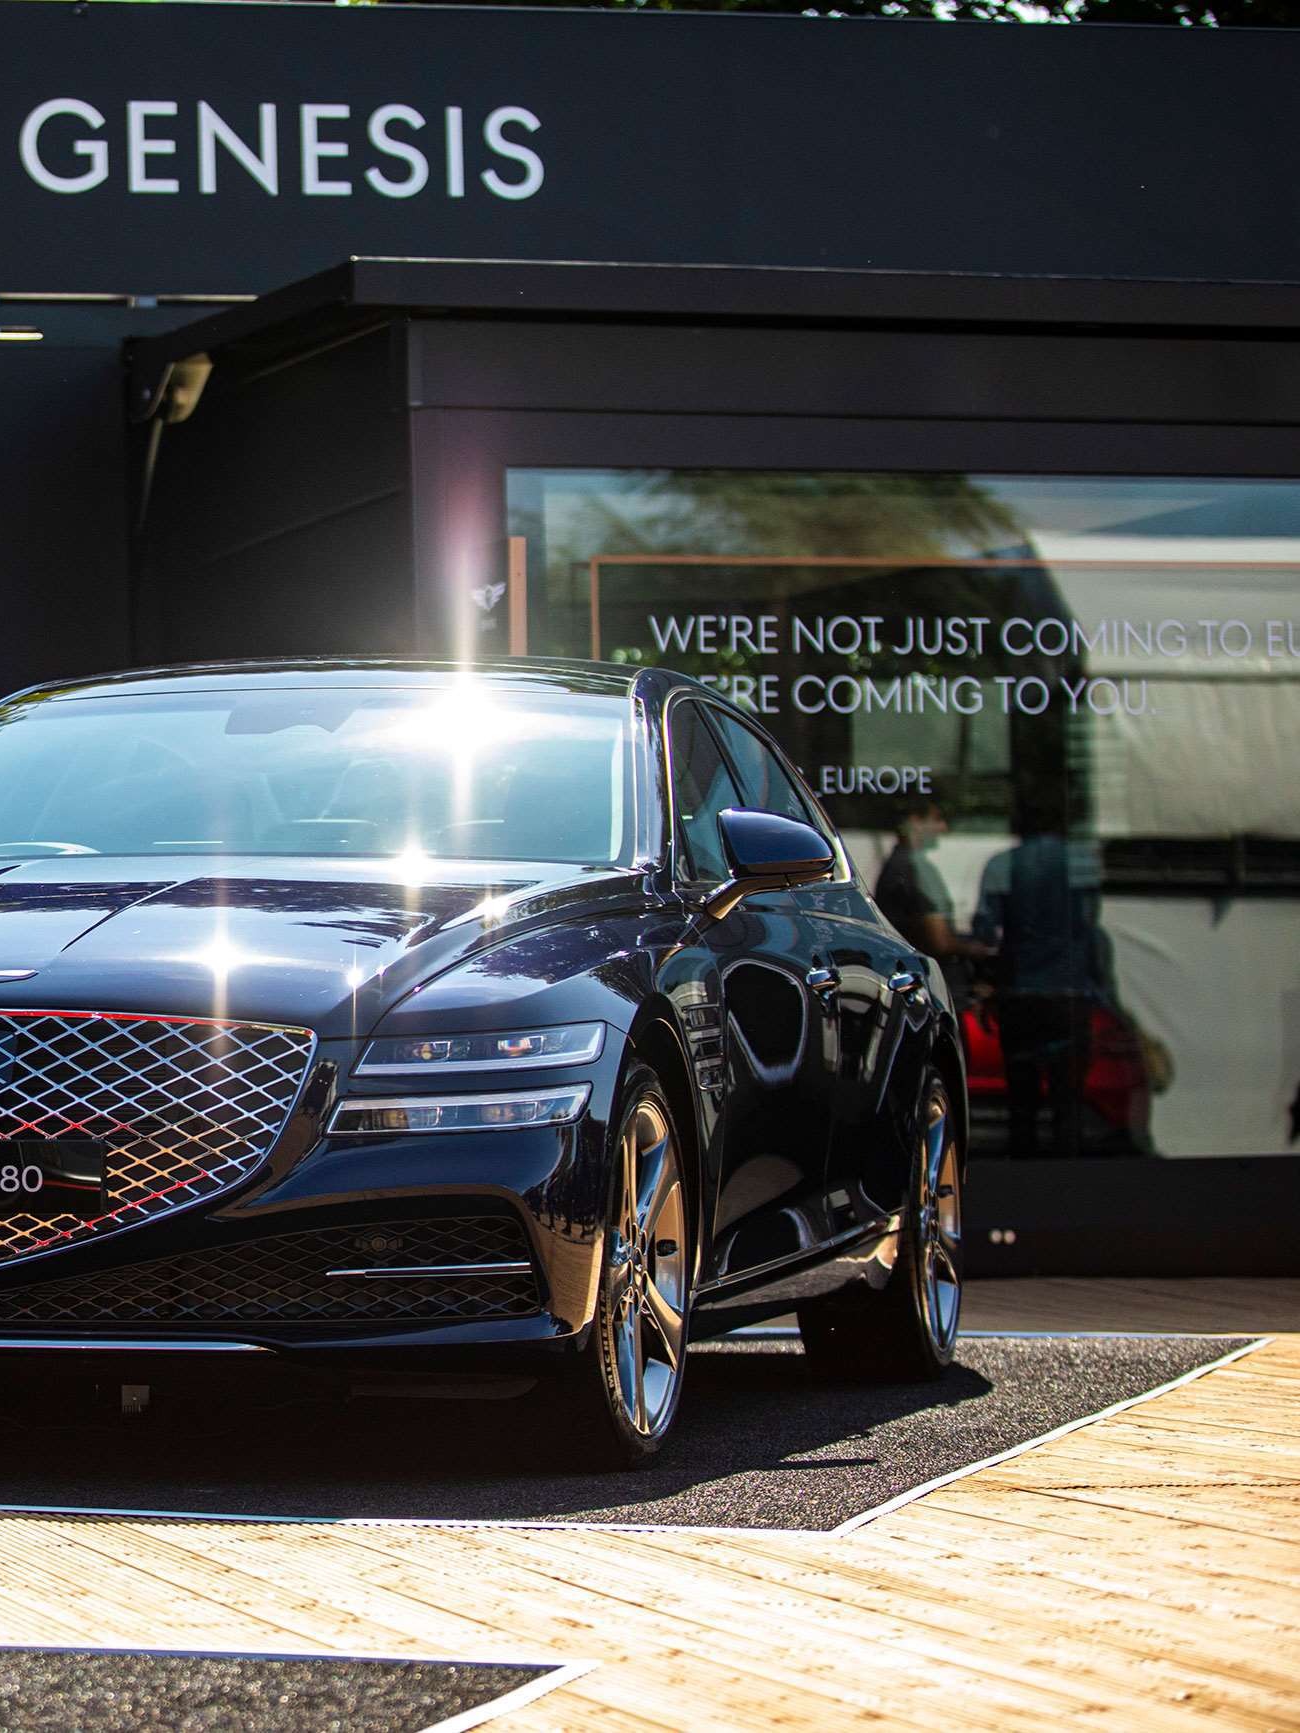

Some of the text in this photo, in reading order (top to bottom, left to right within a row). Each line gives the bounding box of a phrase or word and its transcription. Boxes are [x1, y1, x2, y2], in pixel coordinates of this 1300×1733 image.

[18, 97, 545, 200] GENESIS
[648, 614, 780, 654] WE'RE
[791, 615, 885, 655] NOT
[891, 616, 992, 656] JUST
[1000, 616, 1188, 657] COMING
[1198, 618, 1252, 658] TO
[792, 673, 984, 715] COMING
[993, 675, 1050, 715] TO
[1059, 676, 1157, 716] YOU.
[600, 1288, 615, 1389] MICHELIN
